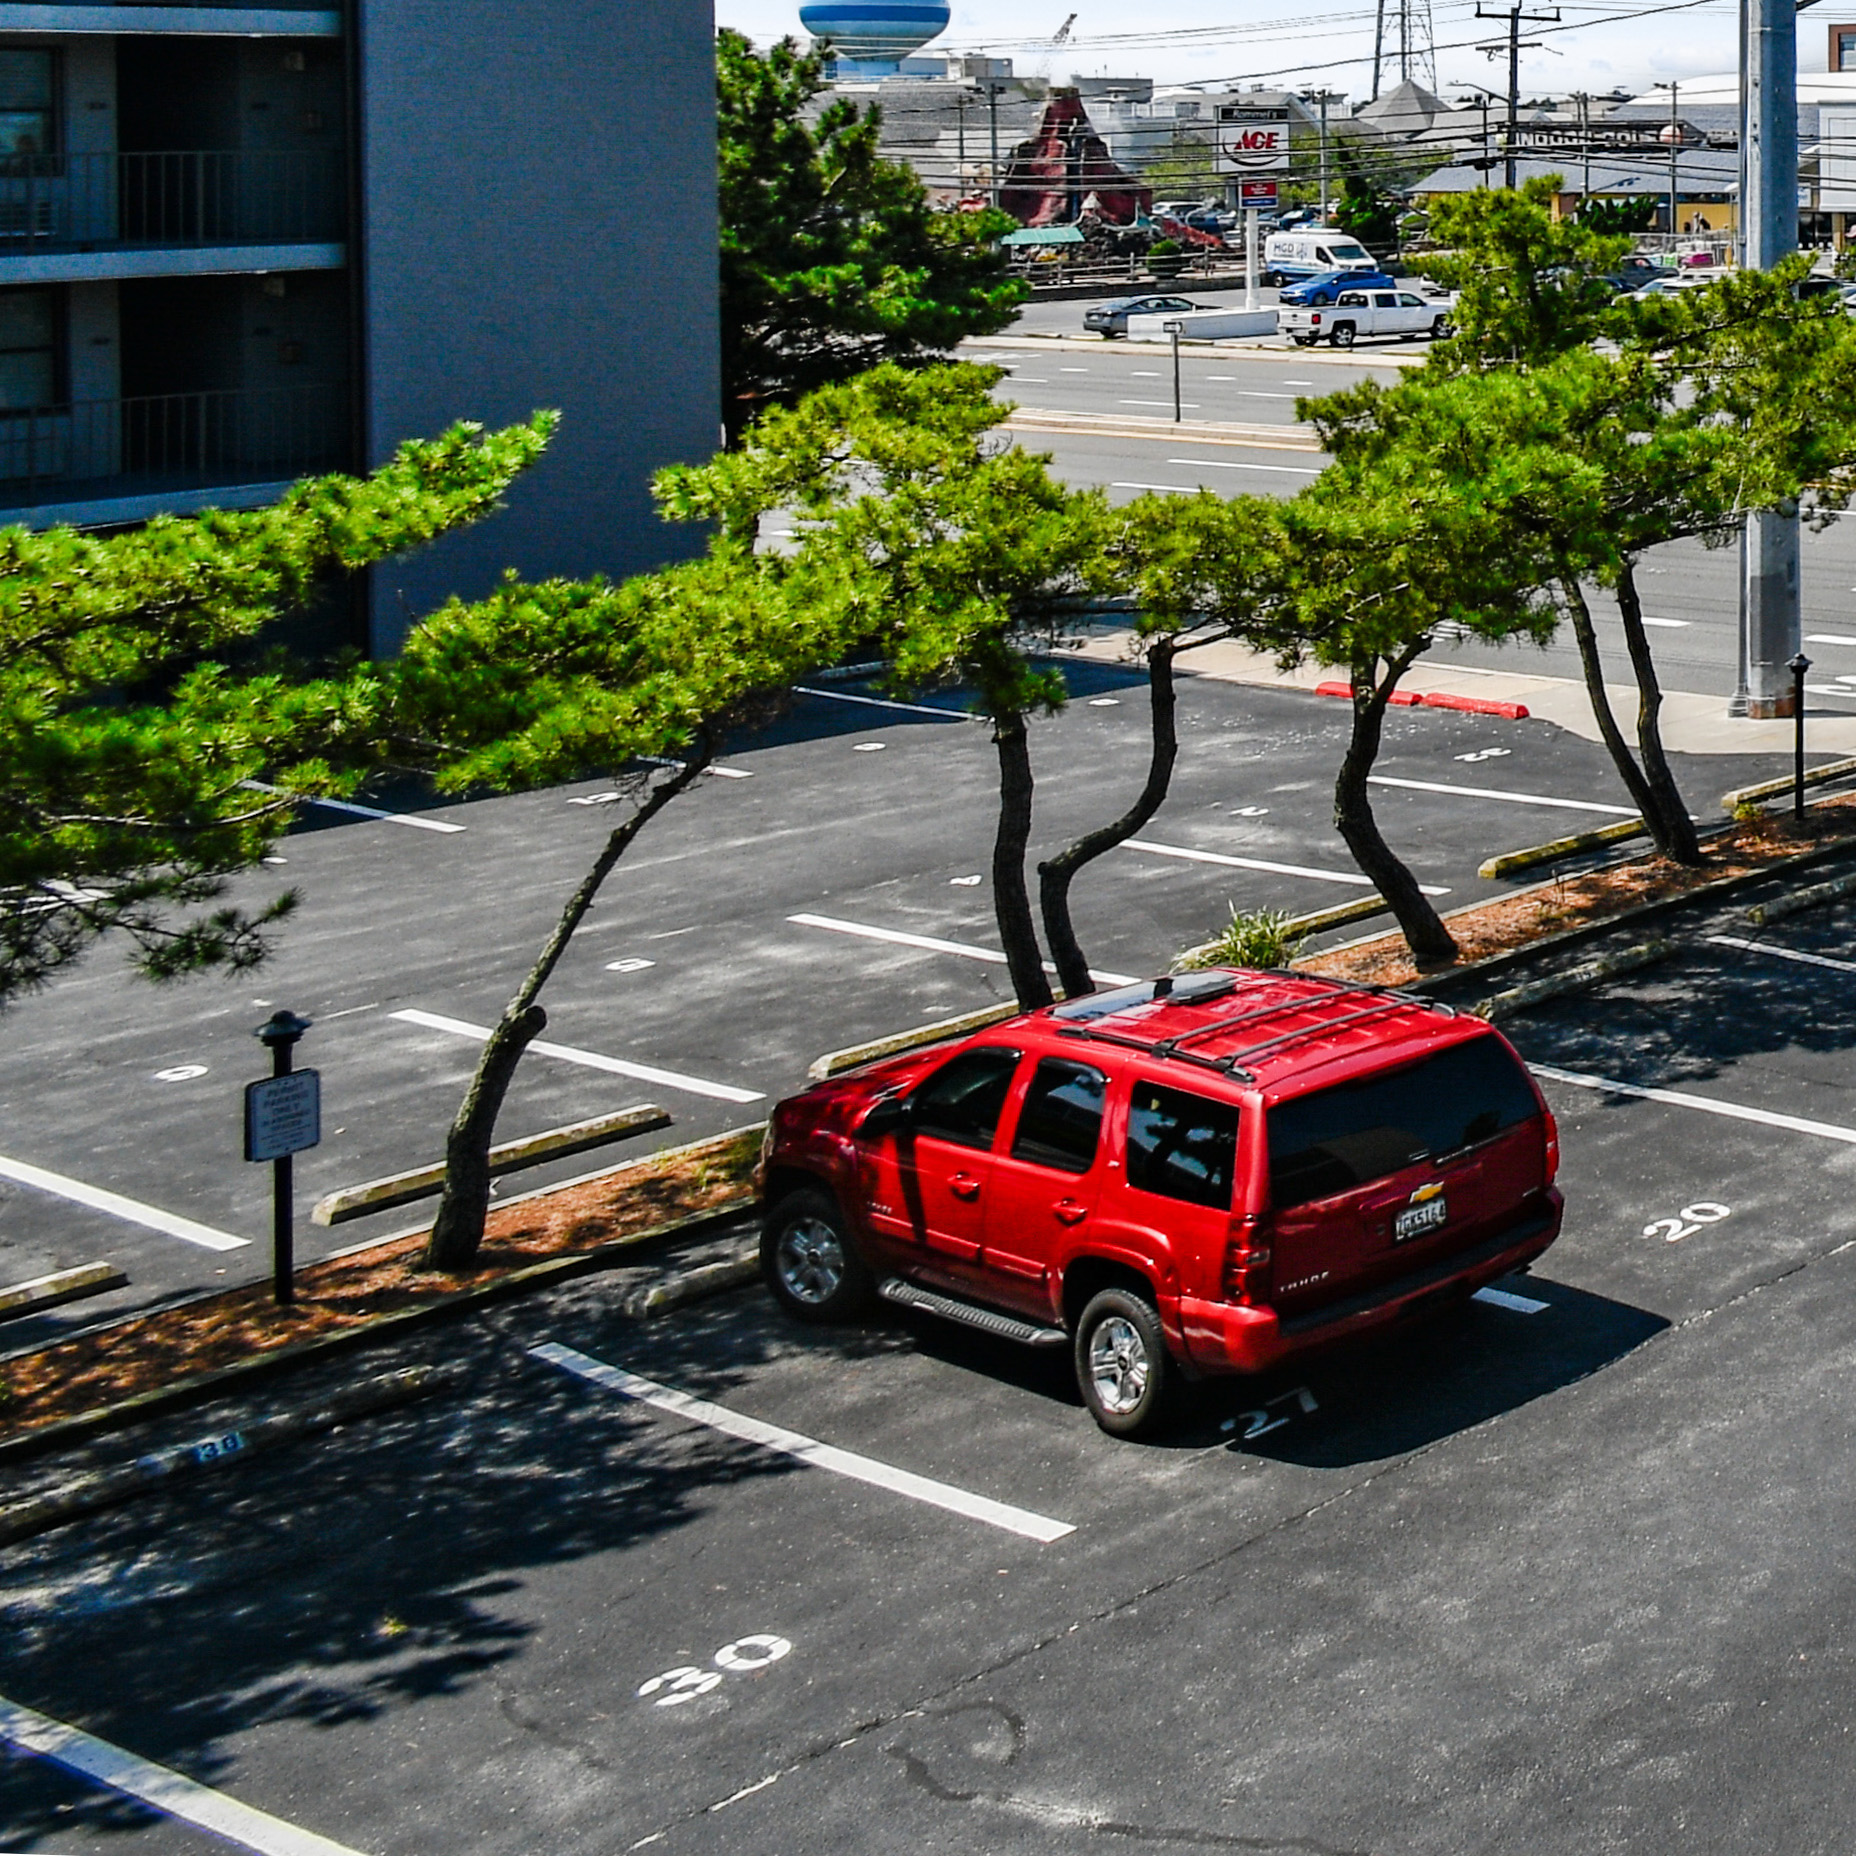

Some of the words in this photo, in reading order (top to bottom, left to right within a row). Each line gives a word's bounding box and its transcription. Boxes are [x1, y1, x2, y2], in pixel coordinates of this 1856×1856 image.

[1233, 128, 1279, 150] ACE
[1643, 1202, 1731, 1241] 20
[1220, 1386, 1319, 1438] 27
[638, 1634, 792, 1706] 30
